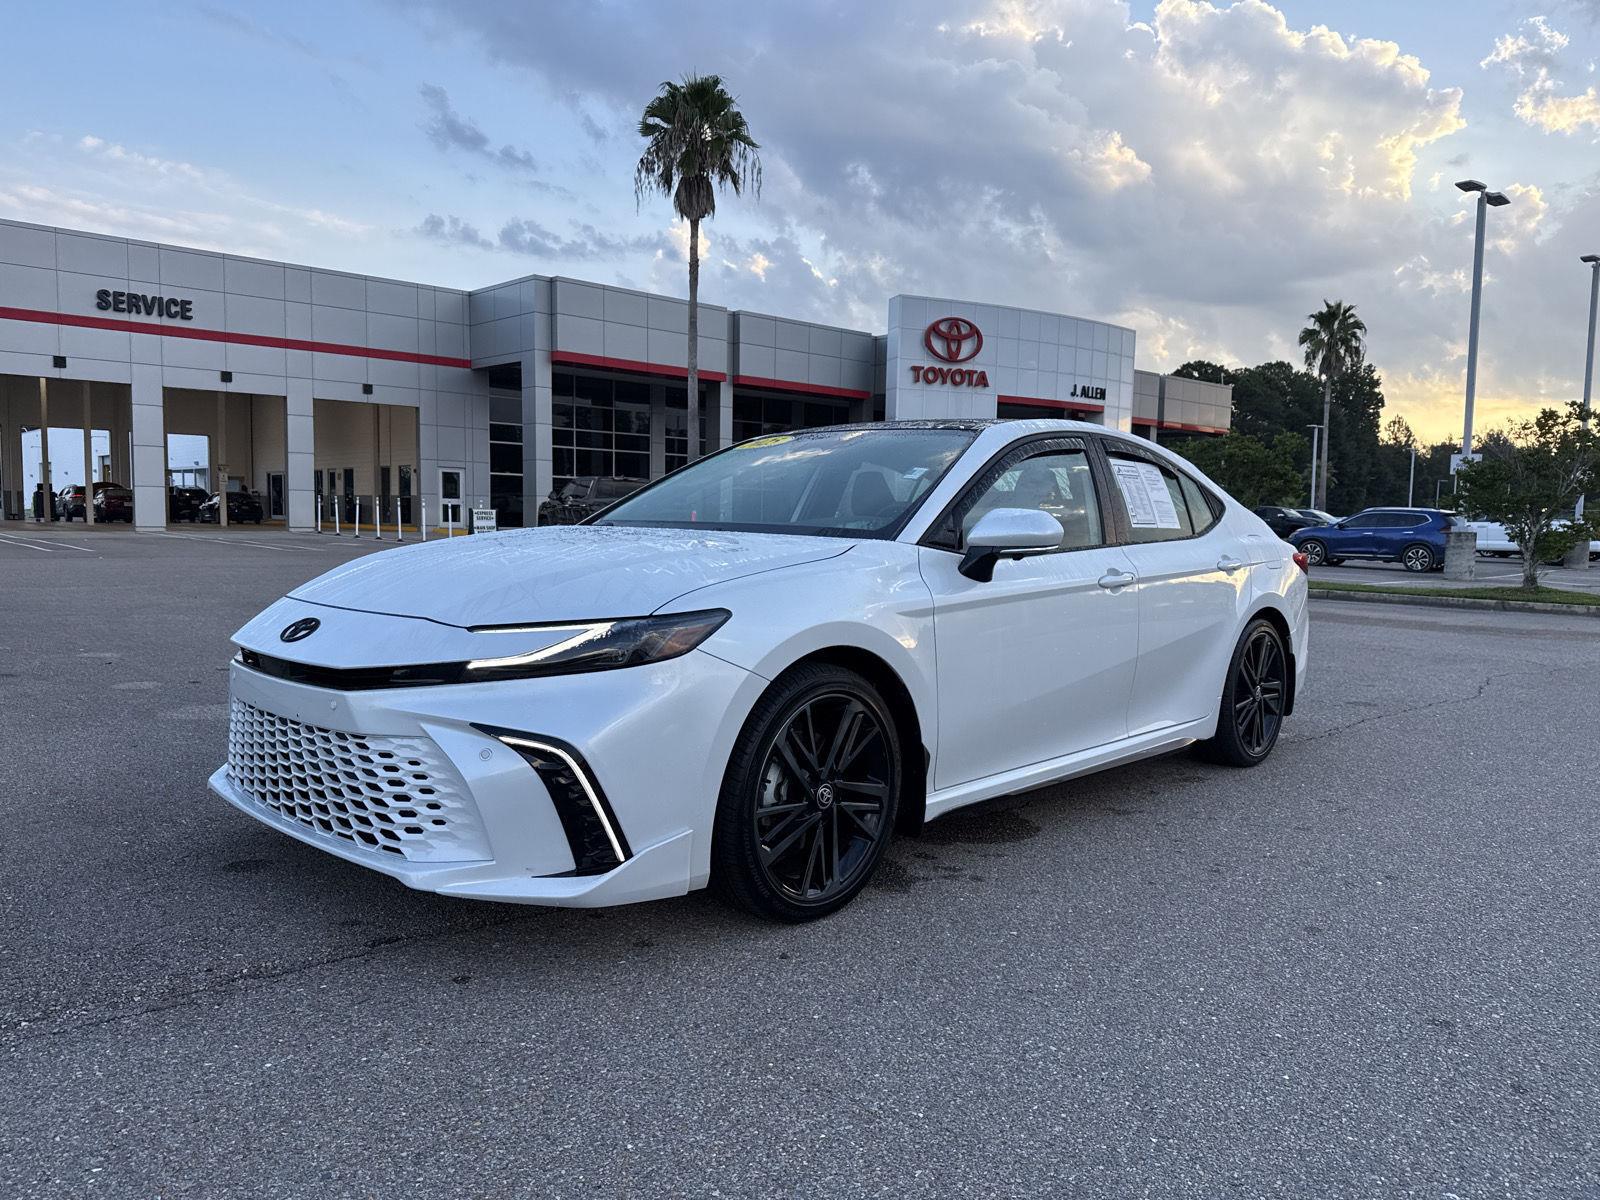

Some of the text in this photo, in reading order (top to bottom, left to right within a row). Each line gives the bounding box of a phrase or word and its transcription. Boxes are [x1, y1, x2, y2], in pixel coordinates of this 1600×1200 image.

[96, 289, 193, 320] SERVICE
[910, 366, 989, 387] TOYOTA
[1070, 384, 1106, 400] J. ALLEN
